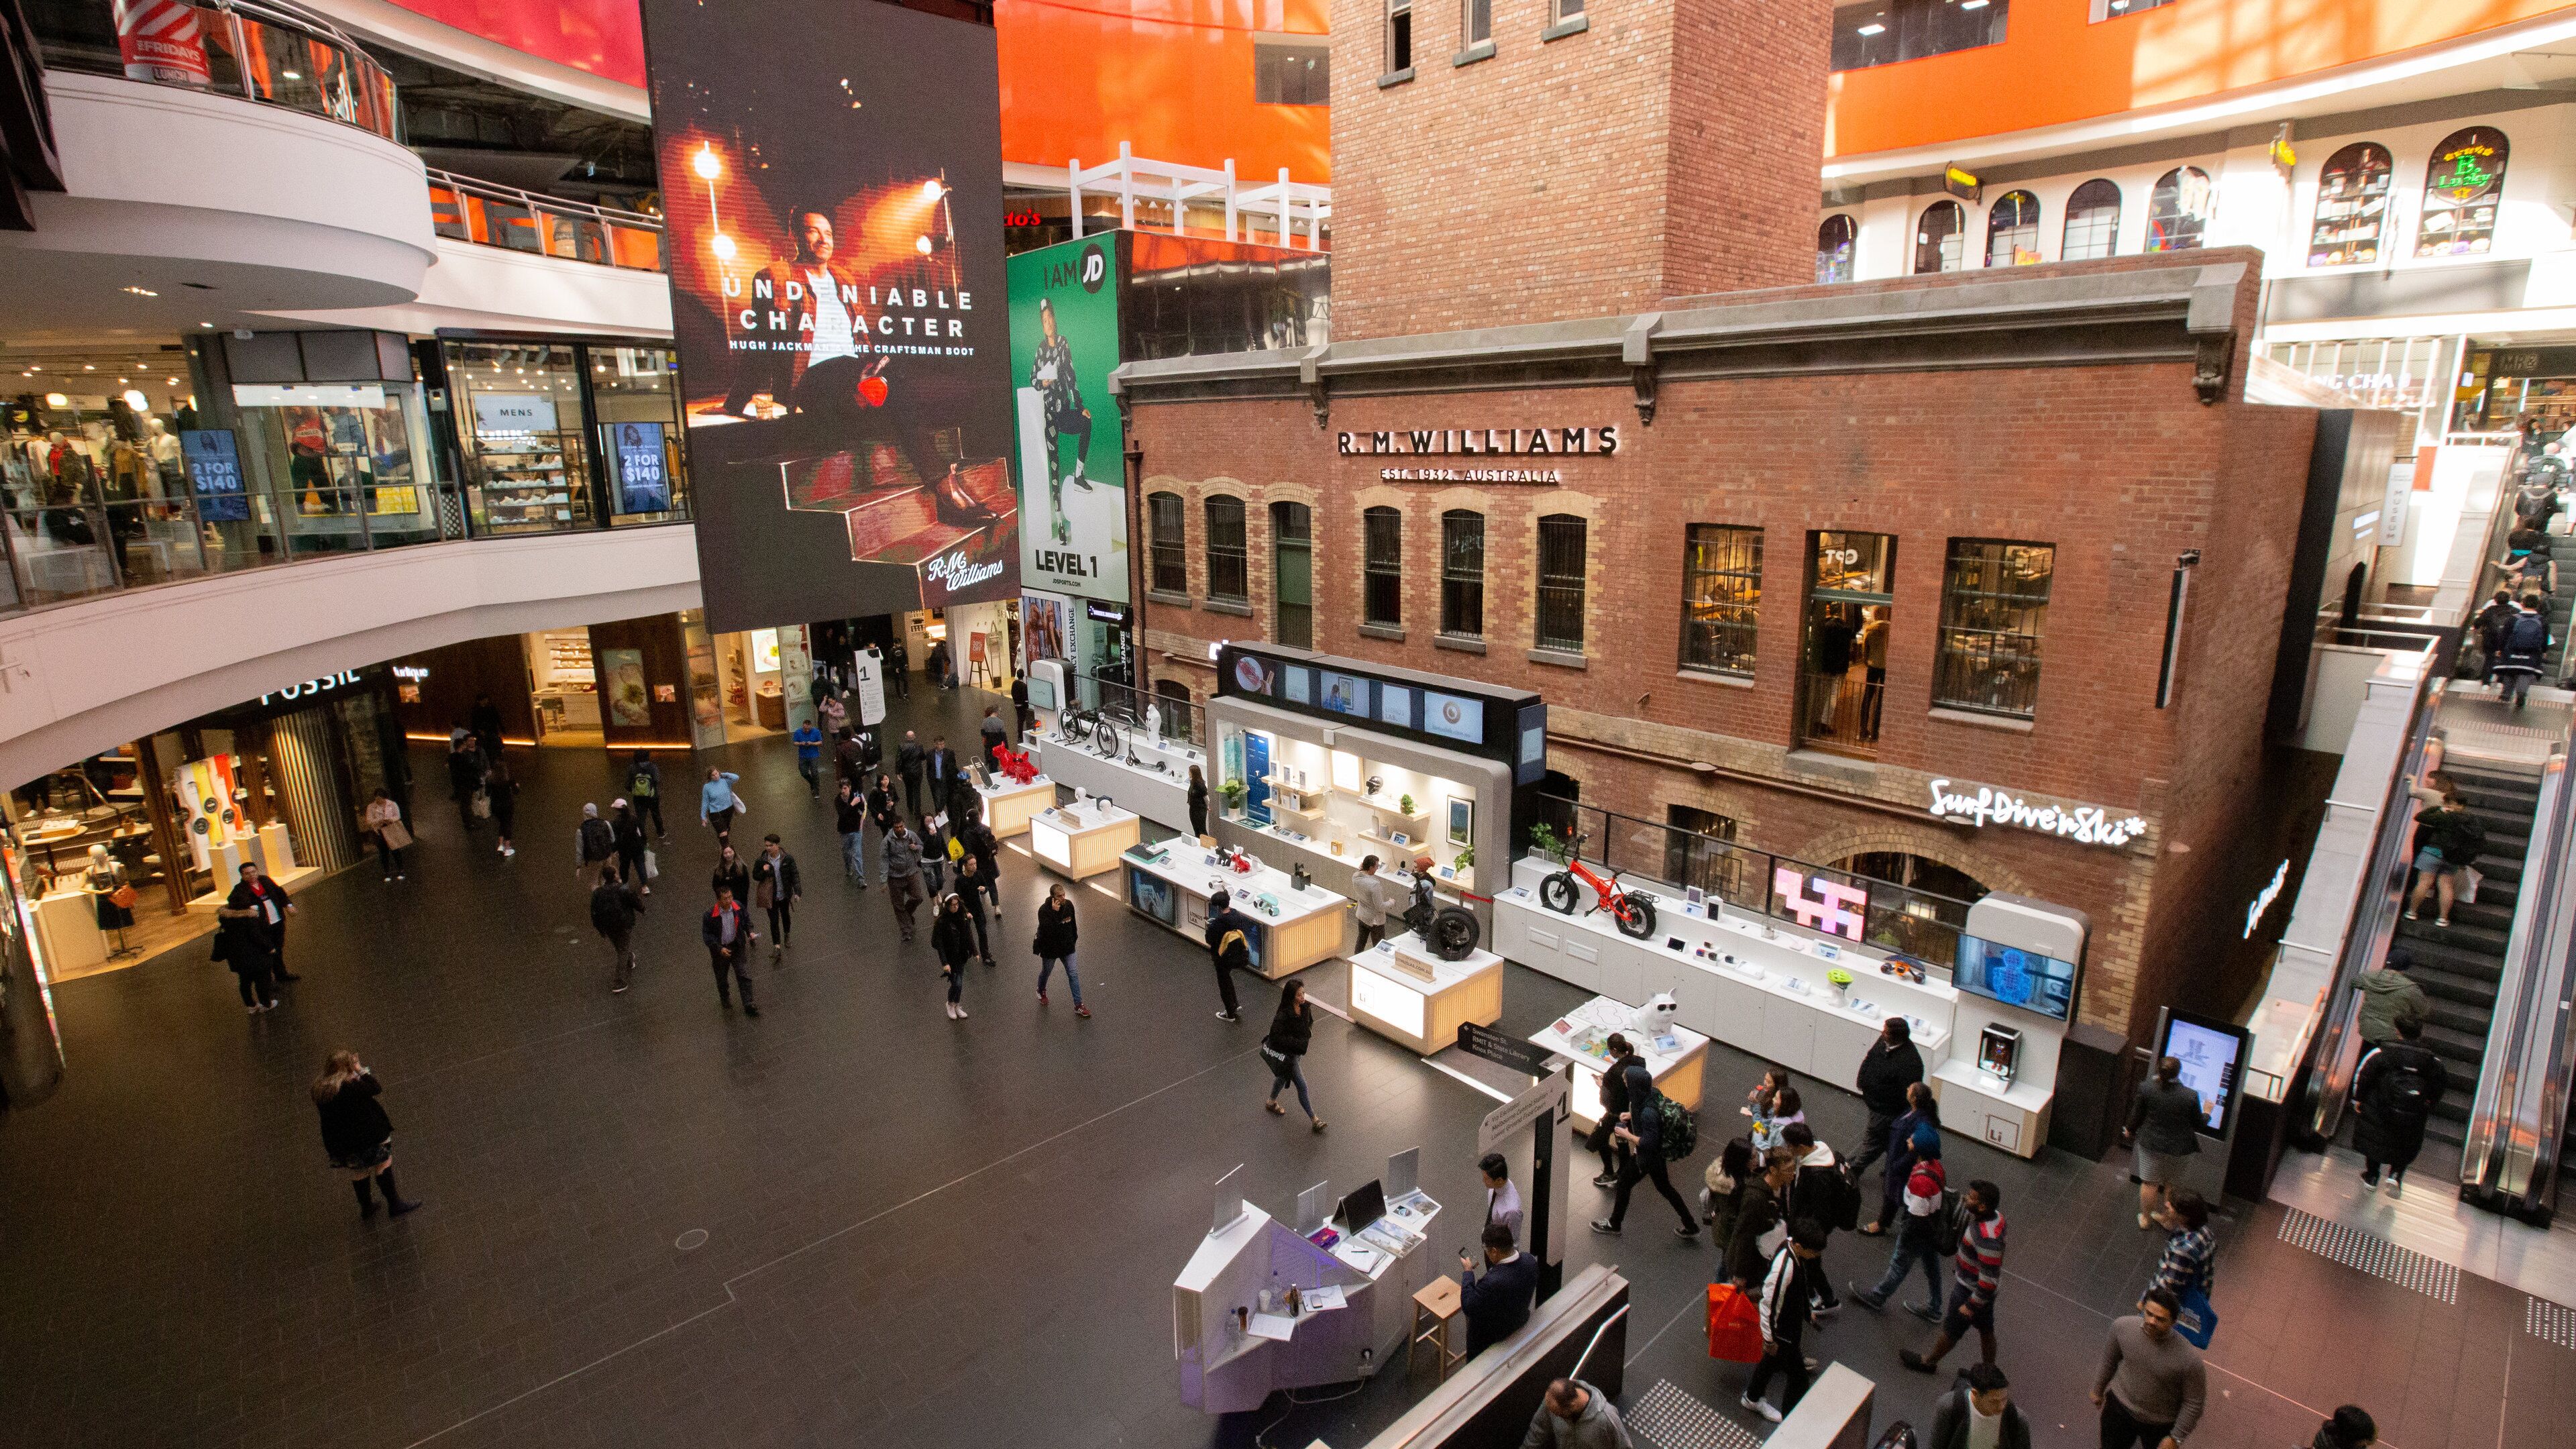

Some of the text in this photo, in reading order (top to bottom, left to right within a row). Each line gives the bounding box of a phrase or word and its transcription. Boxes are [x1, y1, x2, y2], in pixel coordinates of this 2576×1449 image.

[144, 40, 201, 62] FRIDAYS
[2438, 172, 2491, 189] Lucky
[1051, 260, 1077, 289] AM
[1083, 254, 1104, 283] JD
[724, 277, 972, 310] UNDENIABLE
[739, 309, 963, 337] CHARACTER
[729, 340, 766, 350] HUGH
[772, 341, 830, 352] JACKMAN
[848, 343, 869, 354] THE
[874, 345, 941, 355] CRAFTSMAN
[946, 347, 974, 356] BOOT
[500, 409, 533, 417] MENS
[193, 462, 235, 475] 2 FOR
[624, 454, 659, 466] 2 FOR
[627, 466, 660, 482] $140
[1464, 470, 1558, 483] AUSTRALIA
[1035, 549, 1097, 578] LEVEL 1
[946, 559, 1003, 592] Williams
[1053, 578, 1081, 588] JDSPORTS.COM
[1068, 607, 1077, 653] EXCHANGE
[1472, 1027, 1499, 1042] Swanston
[1472, 1035, 1487, 1046] RMIT
[1493, 1044, 1507, 1054] State
[1509, 1048, 1530, 1062] Library
[1472, 1044, 1503, 1061] Knox Place
[1990, 1129, 2002, 1142] Li
